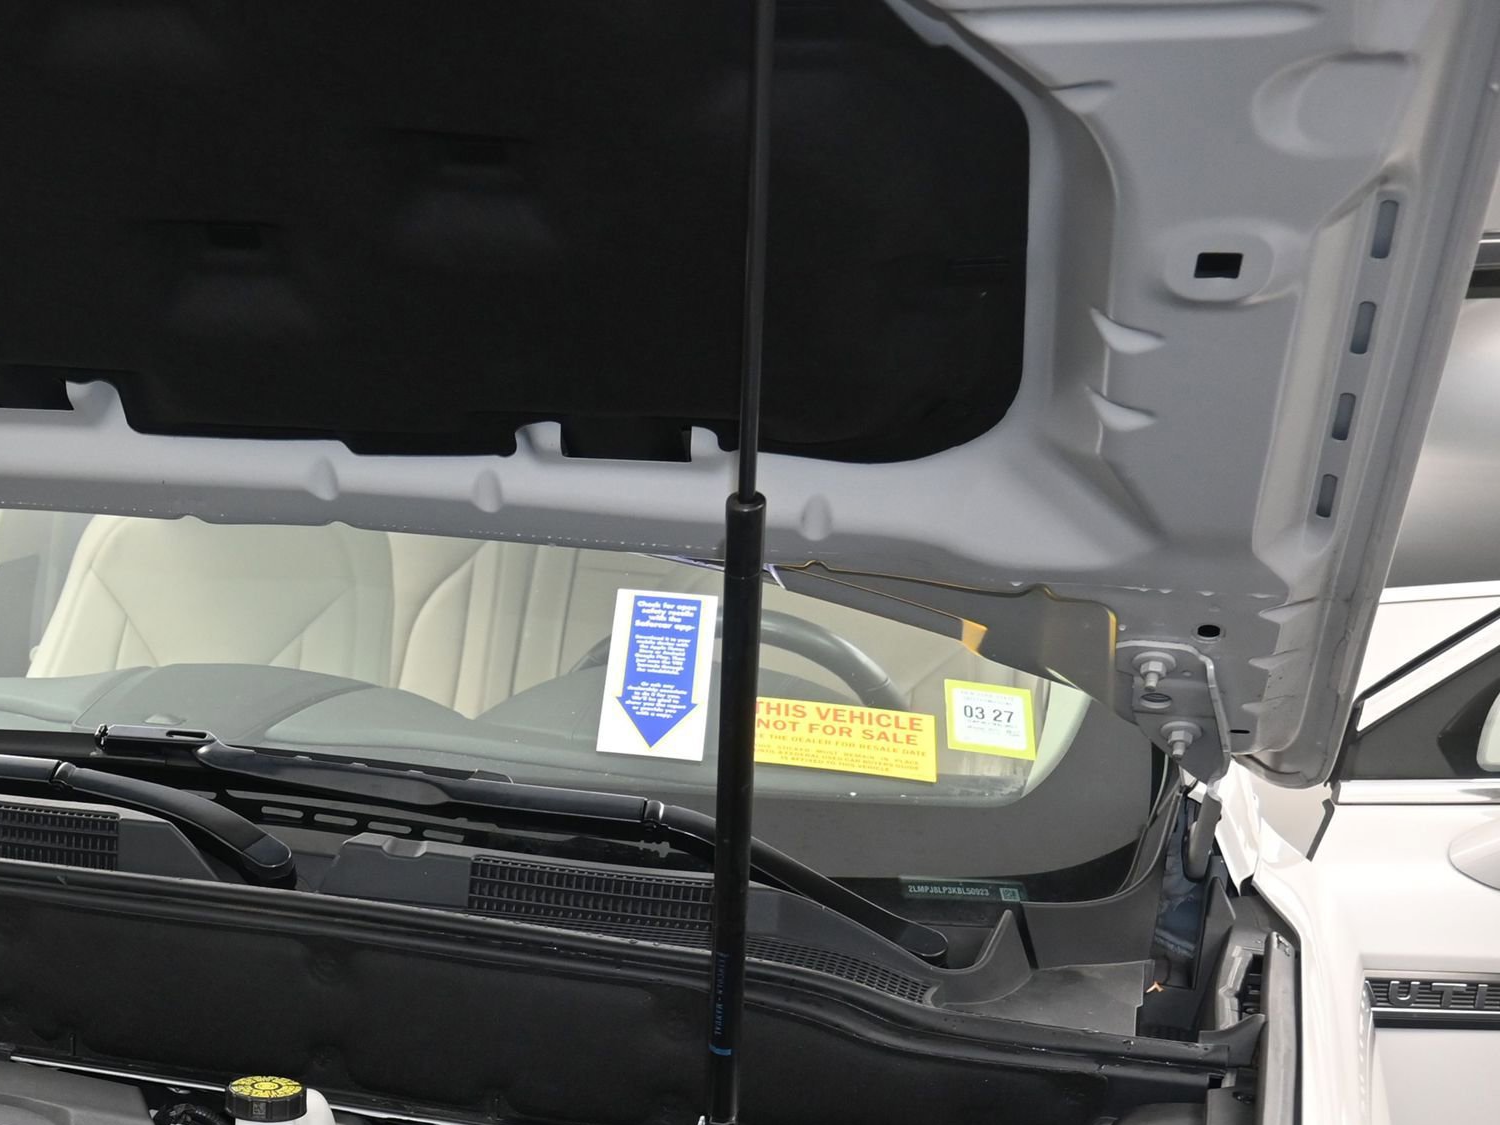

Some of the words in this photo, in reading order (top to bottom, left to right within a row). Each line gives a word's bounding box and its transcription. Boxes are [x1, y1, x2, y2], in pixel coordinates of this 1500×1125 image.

[756, 701, 807, 718] THIS
[815, 706, 923, 732] VEHICLE
[964, 704, 985, 720] 03
[992, 709, 1014, 723] 27
[756, 718, 800, 732] NOT
[808, 723, 852, 738] FOR
[862, 729, 918, 746] SALE
